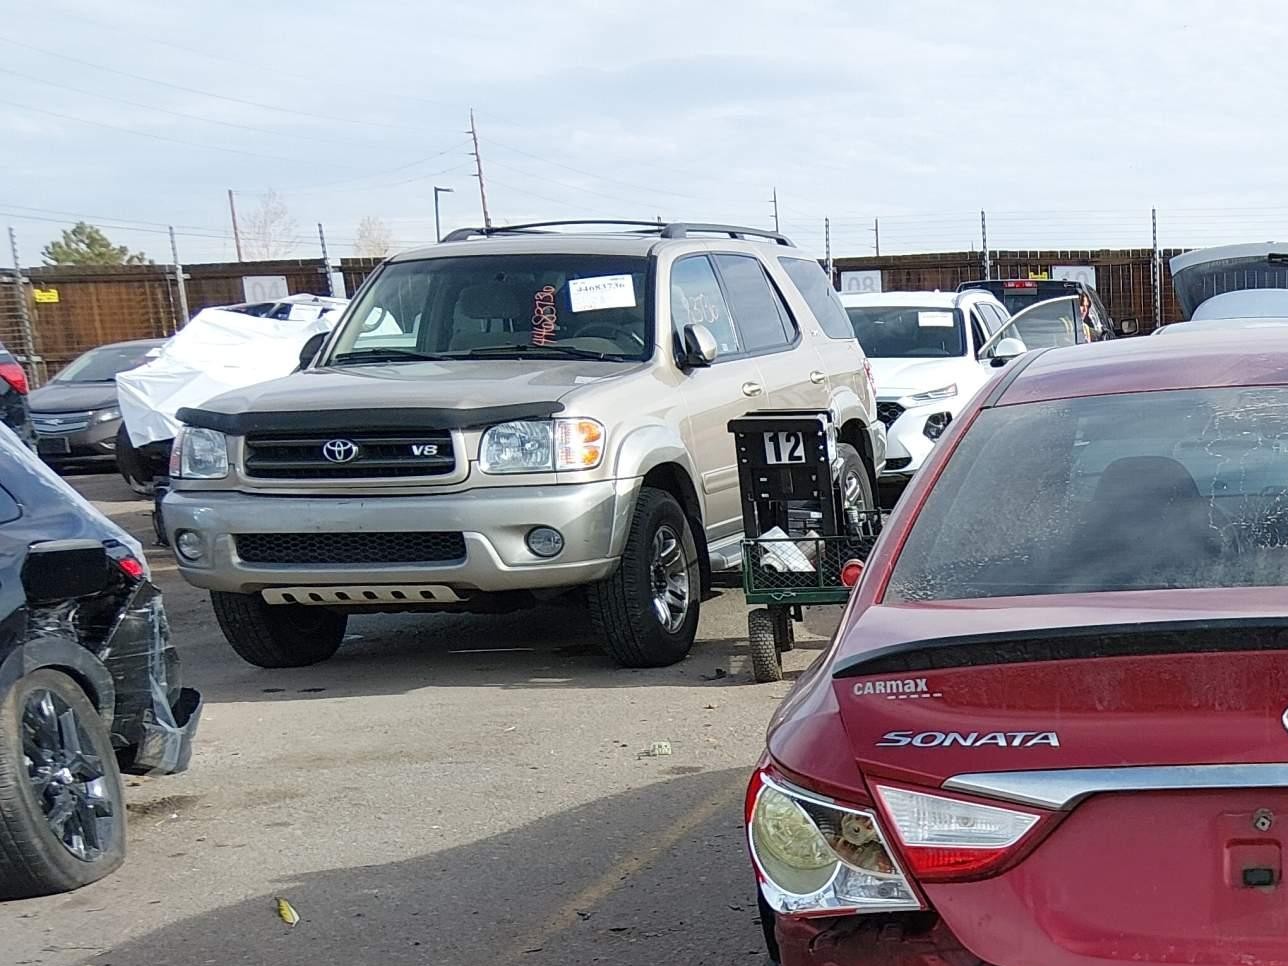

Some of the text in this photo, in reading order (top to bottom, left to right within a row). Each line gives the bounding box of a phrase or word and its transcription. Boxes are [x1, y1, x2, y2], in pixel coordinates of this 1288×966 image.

[411, 444, 438, 456] V8
[768, 431, 803, 462] 12
[875, 731, 1061, 748] SONATA
